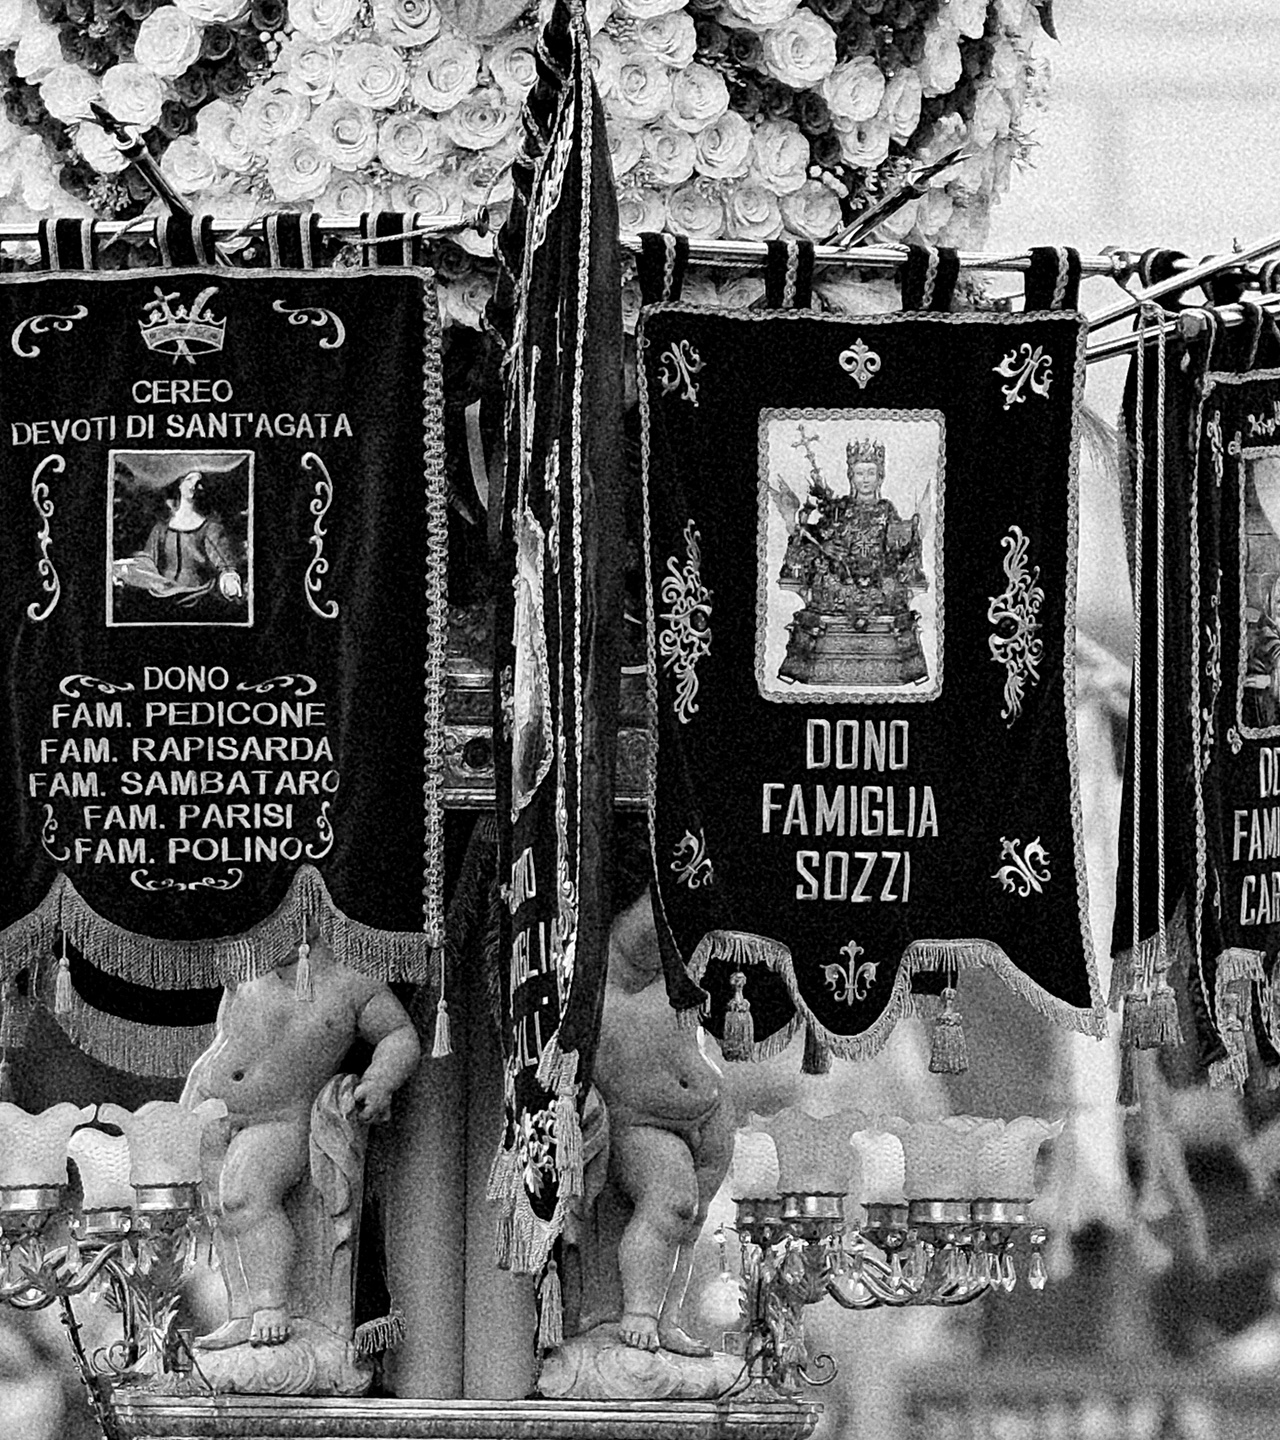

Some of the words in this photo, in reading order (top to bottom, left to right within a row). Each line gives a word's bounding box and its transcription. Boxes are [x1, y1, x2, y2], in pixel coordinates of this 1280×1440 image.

[132, 380, 233, 404] CEREO
[12, 416, 115, 445] DEVOTI
[127, 415, 154, 438] DI
[167, 413, 352, 438] SANT'AGATA
[144, 666, 229, 692] DONO
[53, 702, 131, 728] FAM.
[146, 701, 325, 727] PEDICONE
[41, 738, 117, 763] FAM.
[133, 737, 333, 761] RAPISARDA
[807, 719, 908, 771] DONO
[30, 772, 105, 797] FAM.
[121, 770, 339, 795] SAMBATARO
[84, 805, 164, 829] FAM.
[180, 803, 292, 829] PARISI
[763, 783, 938, 837] FAMIGLIA
[75, 838, 154, 863] FAM.
[169, 836, 302, 863] POLINO
[796, 850, 910, 902] SOZZI
